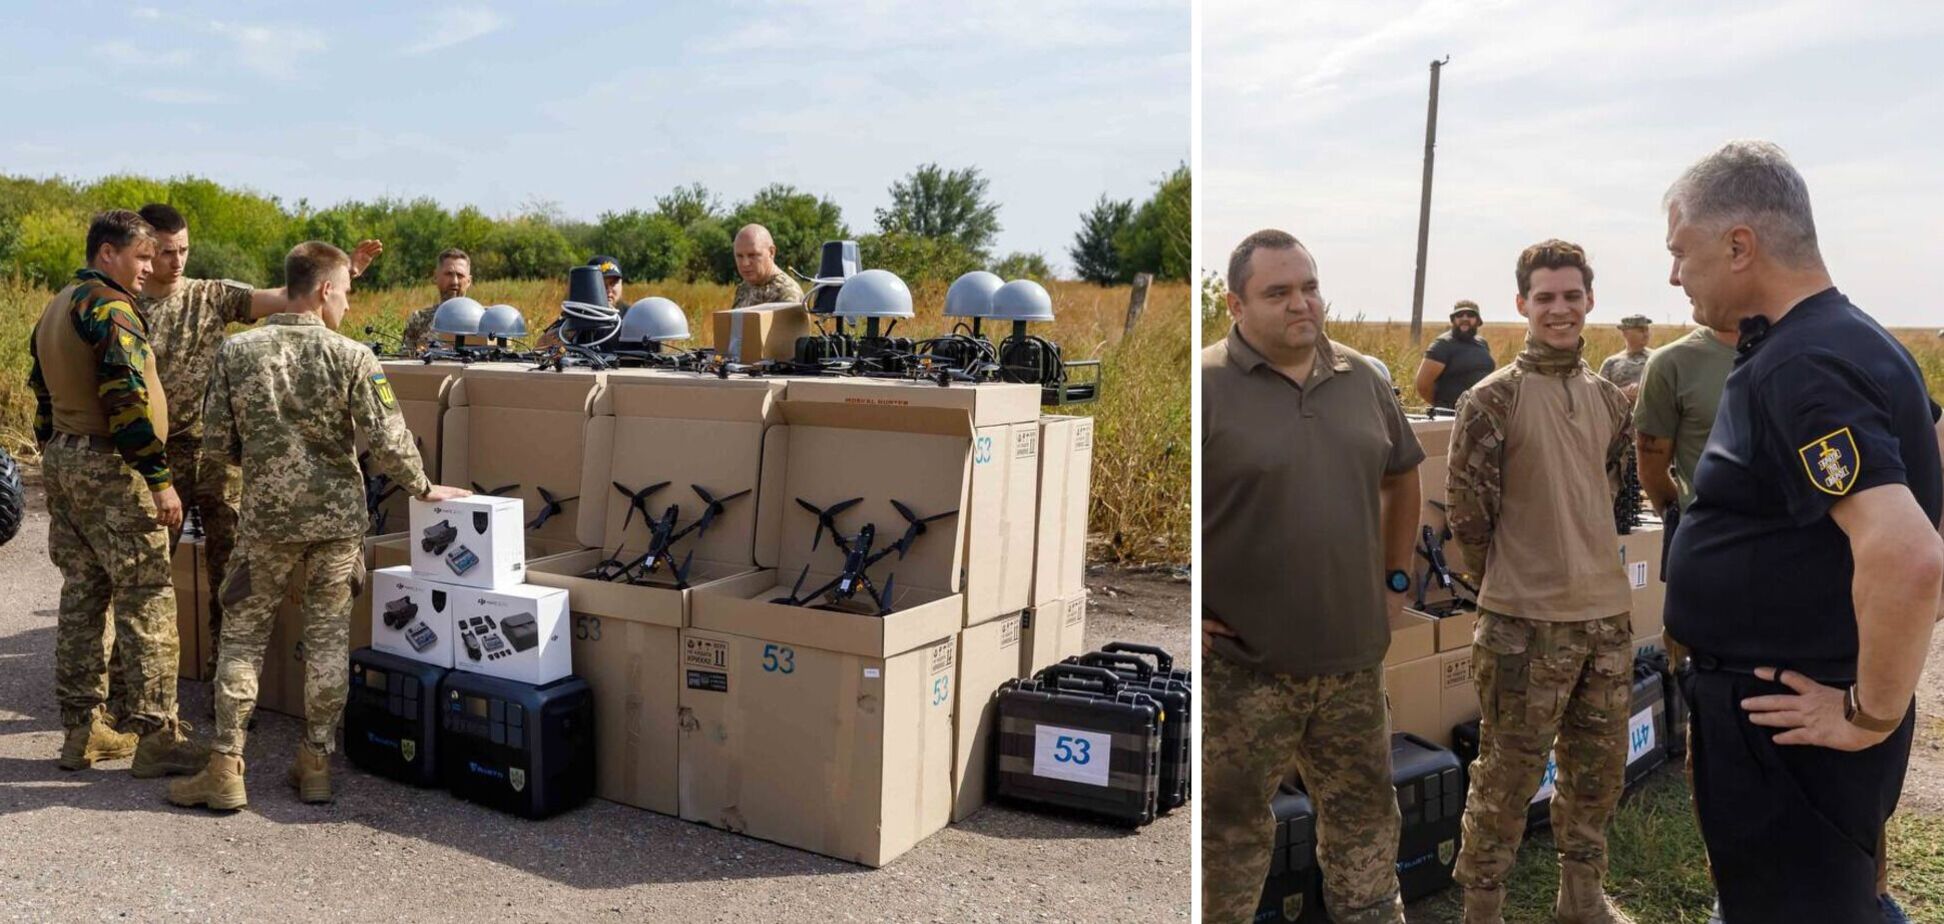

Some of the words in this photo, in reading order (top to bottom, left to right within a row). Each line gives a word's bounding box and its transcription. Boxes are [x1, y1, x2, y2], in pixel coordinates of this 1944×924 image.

[975, 436, 992, 464] 53
[575, 615, 601, 642] 53
[762, 643, 795, 674] 53
[933, 675, 949, 706] 53
[1054, 735, 1091, 766] 53
